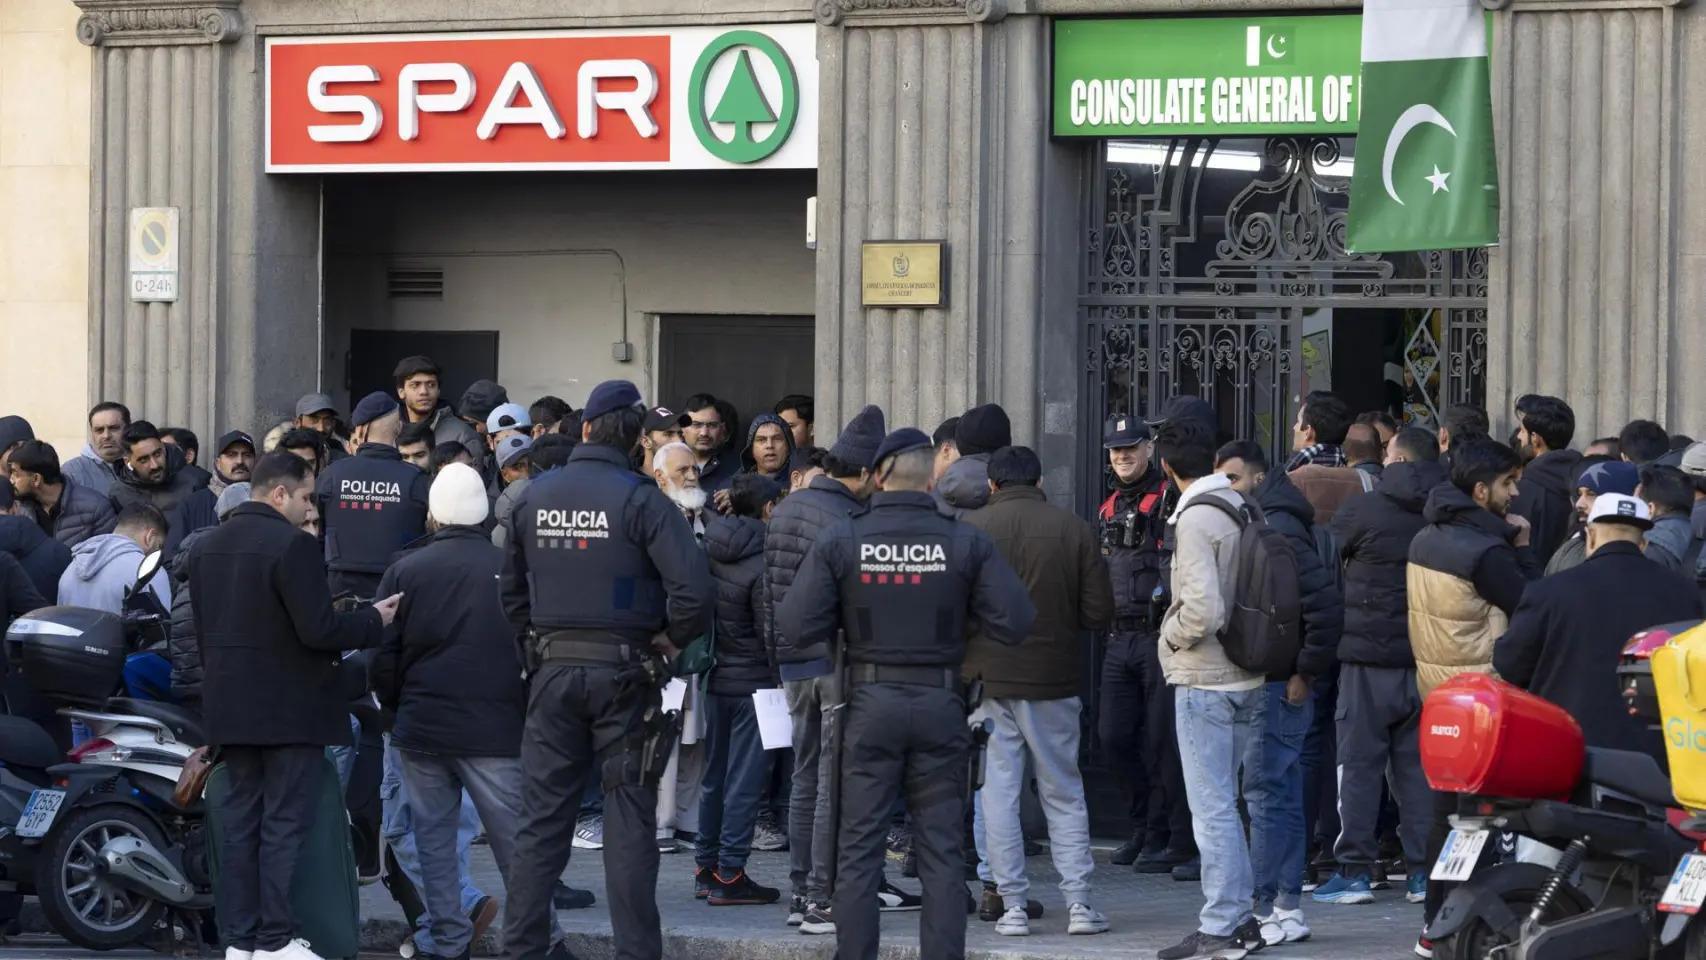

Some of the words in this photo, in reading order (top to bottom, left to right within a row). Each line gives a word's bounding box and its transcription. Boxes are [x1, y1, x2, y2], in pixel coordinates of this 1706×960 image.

[306, 58, 659, 142] SPAR
[1070, 77, 1206, 126] CONSULATE
[1211, 75, 1317, 123] GENERAL
[1322, 74, 1353, 123] OF
[340, 479, 401, 496] POLICIA
[340, 493, 364, 501] mossos
[536, 508, 609, 529] POLICIA
[536, 528, 565, 537] mossos
[565, 528, 609, 539] d'esquadra
[860, 543, 947, 562] POLICIA
[860, 562, 895, 572] mossos
[896, 562, 947, 573] d'esquadra
[33, 793, 62, 811] 2552
